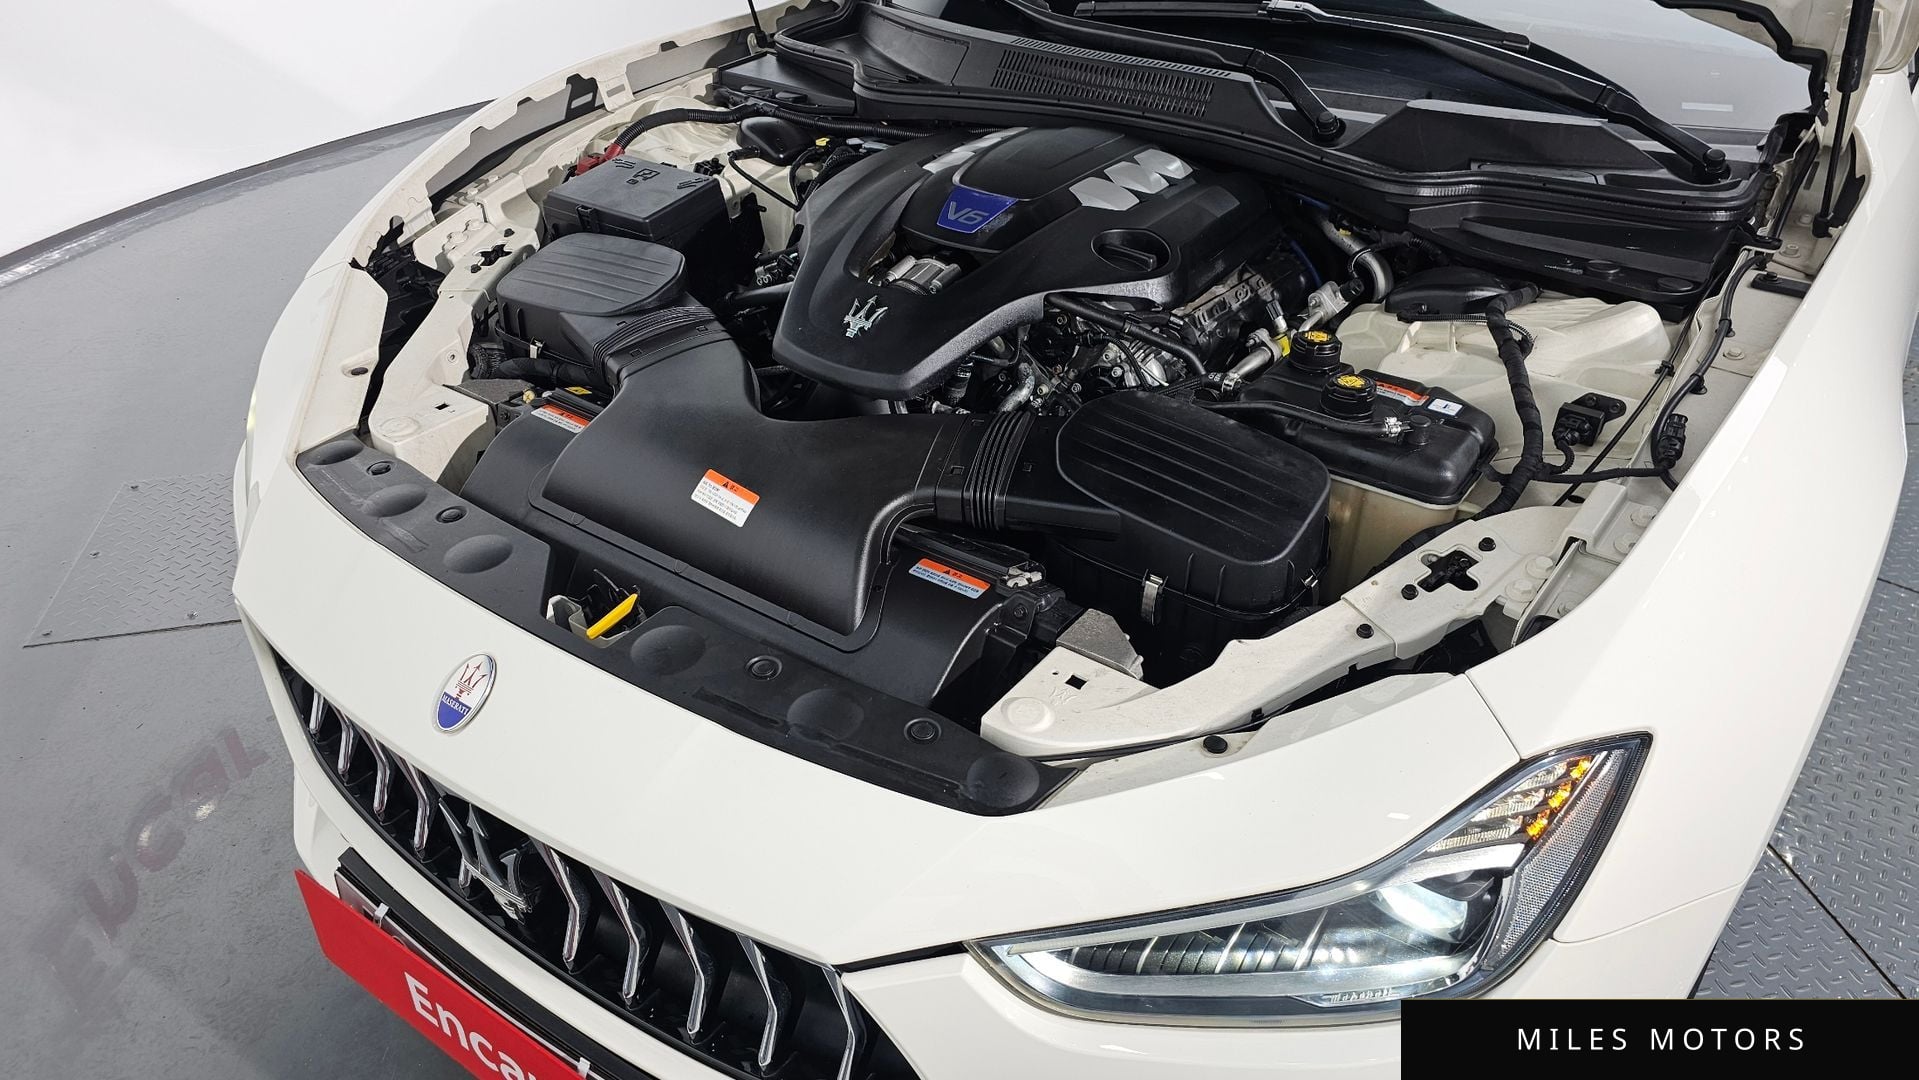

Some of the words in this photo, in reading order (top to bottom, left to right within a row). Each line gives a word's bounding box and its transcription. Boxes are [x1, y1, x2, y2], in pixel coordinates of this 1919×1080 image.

[948, 201, 991, 225] V6
[442, 694, 468, 715] MASERATI
[404, 971, 537, 1080] Enca
